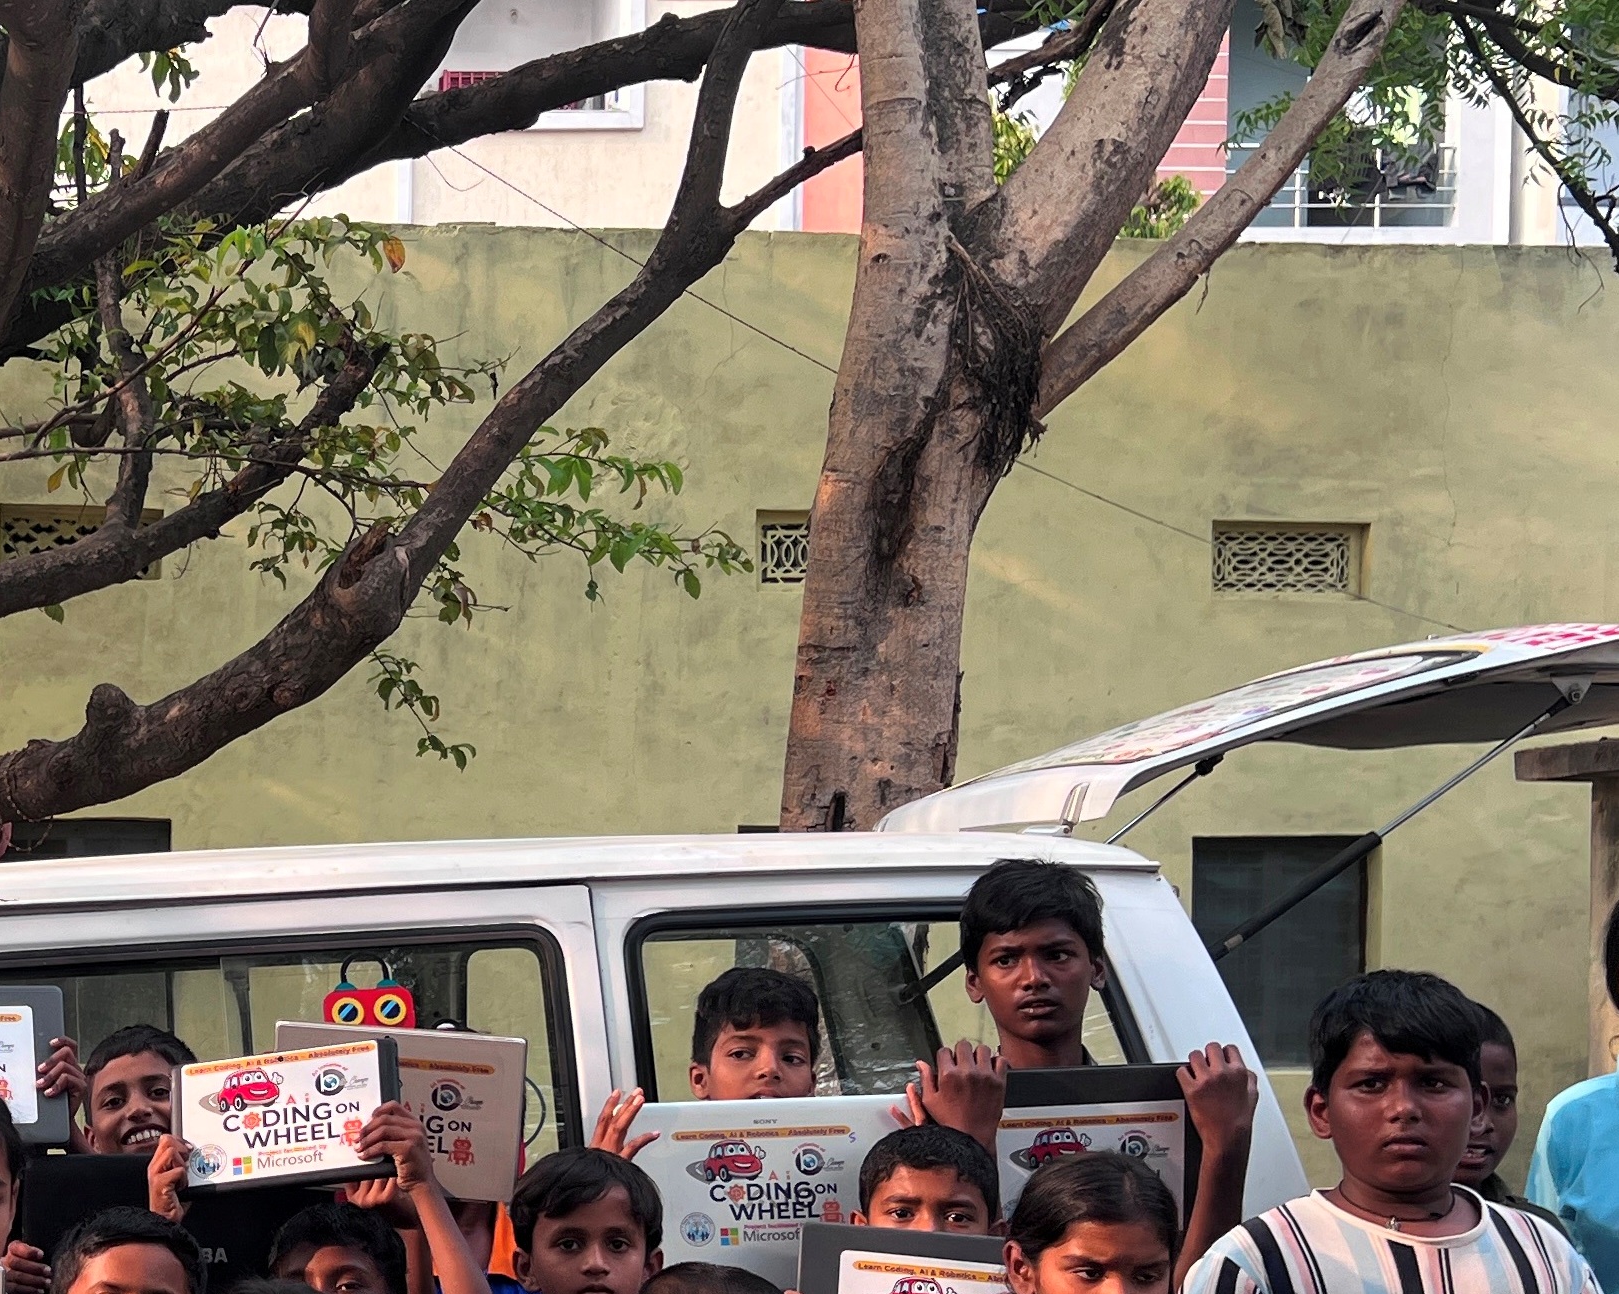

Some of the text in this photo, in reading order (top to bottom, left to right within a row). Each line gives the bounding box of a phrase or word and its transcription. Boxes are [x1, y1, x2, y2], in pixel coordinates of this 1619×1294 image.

[223, 1100, 360, 1132] CODING ON
[243, 1121, 340, 1149] WHEEL
[448, 1120, 472, 1133] ON
[257, 1150, 324, 1170] Microsoft
[815, 1183, 837, 1195] ON
[729, 1201, 820, 1221] WHEEL
[743, 1228, 800, 1242] Microsof
